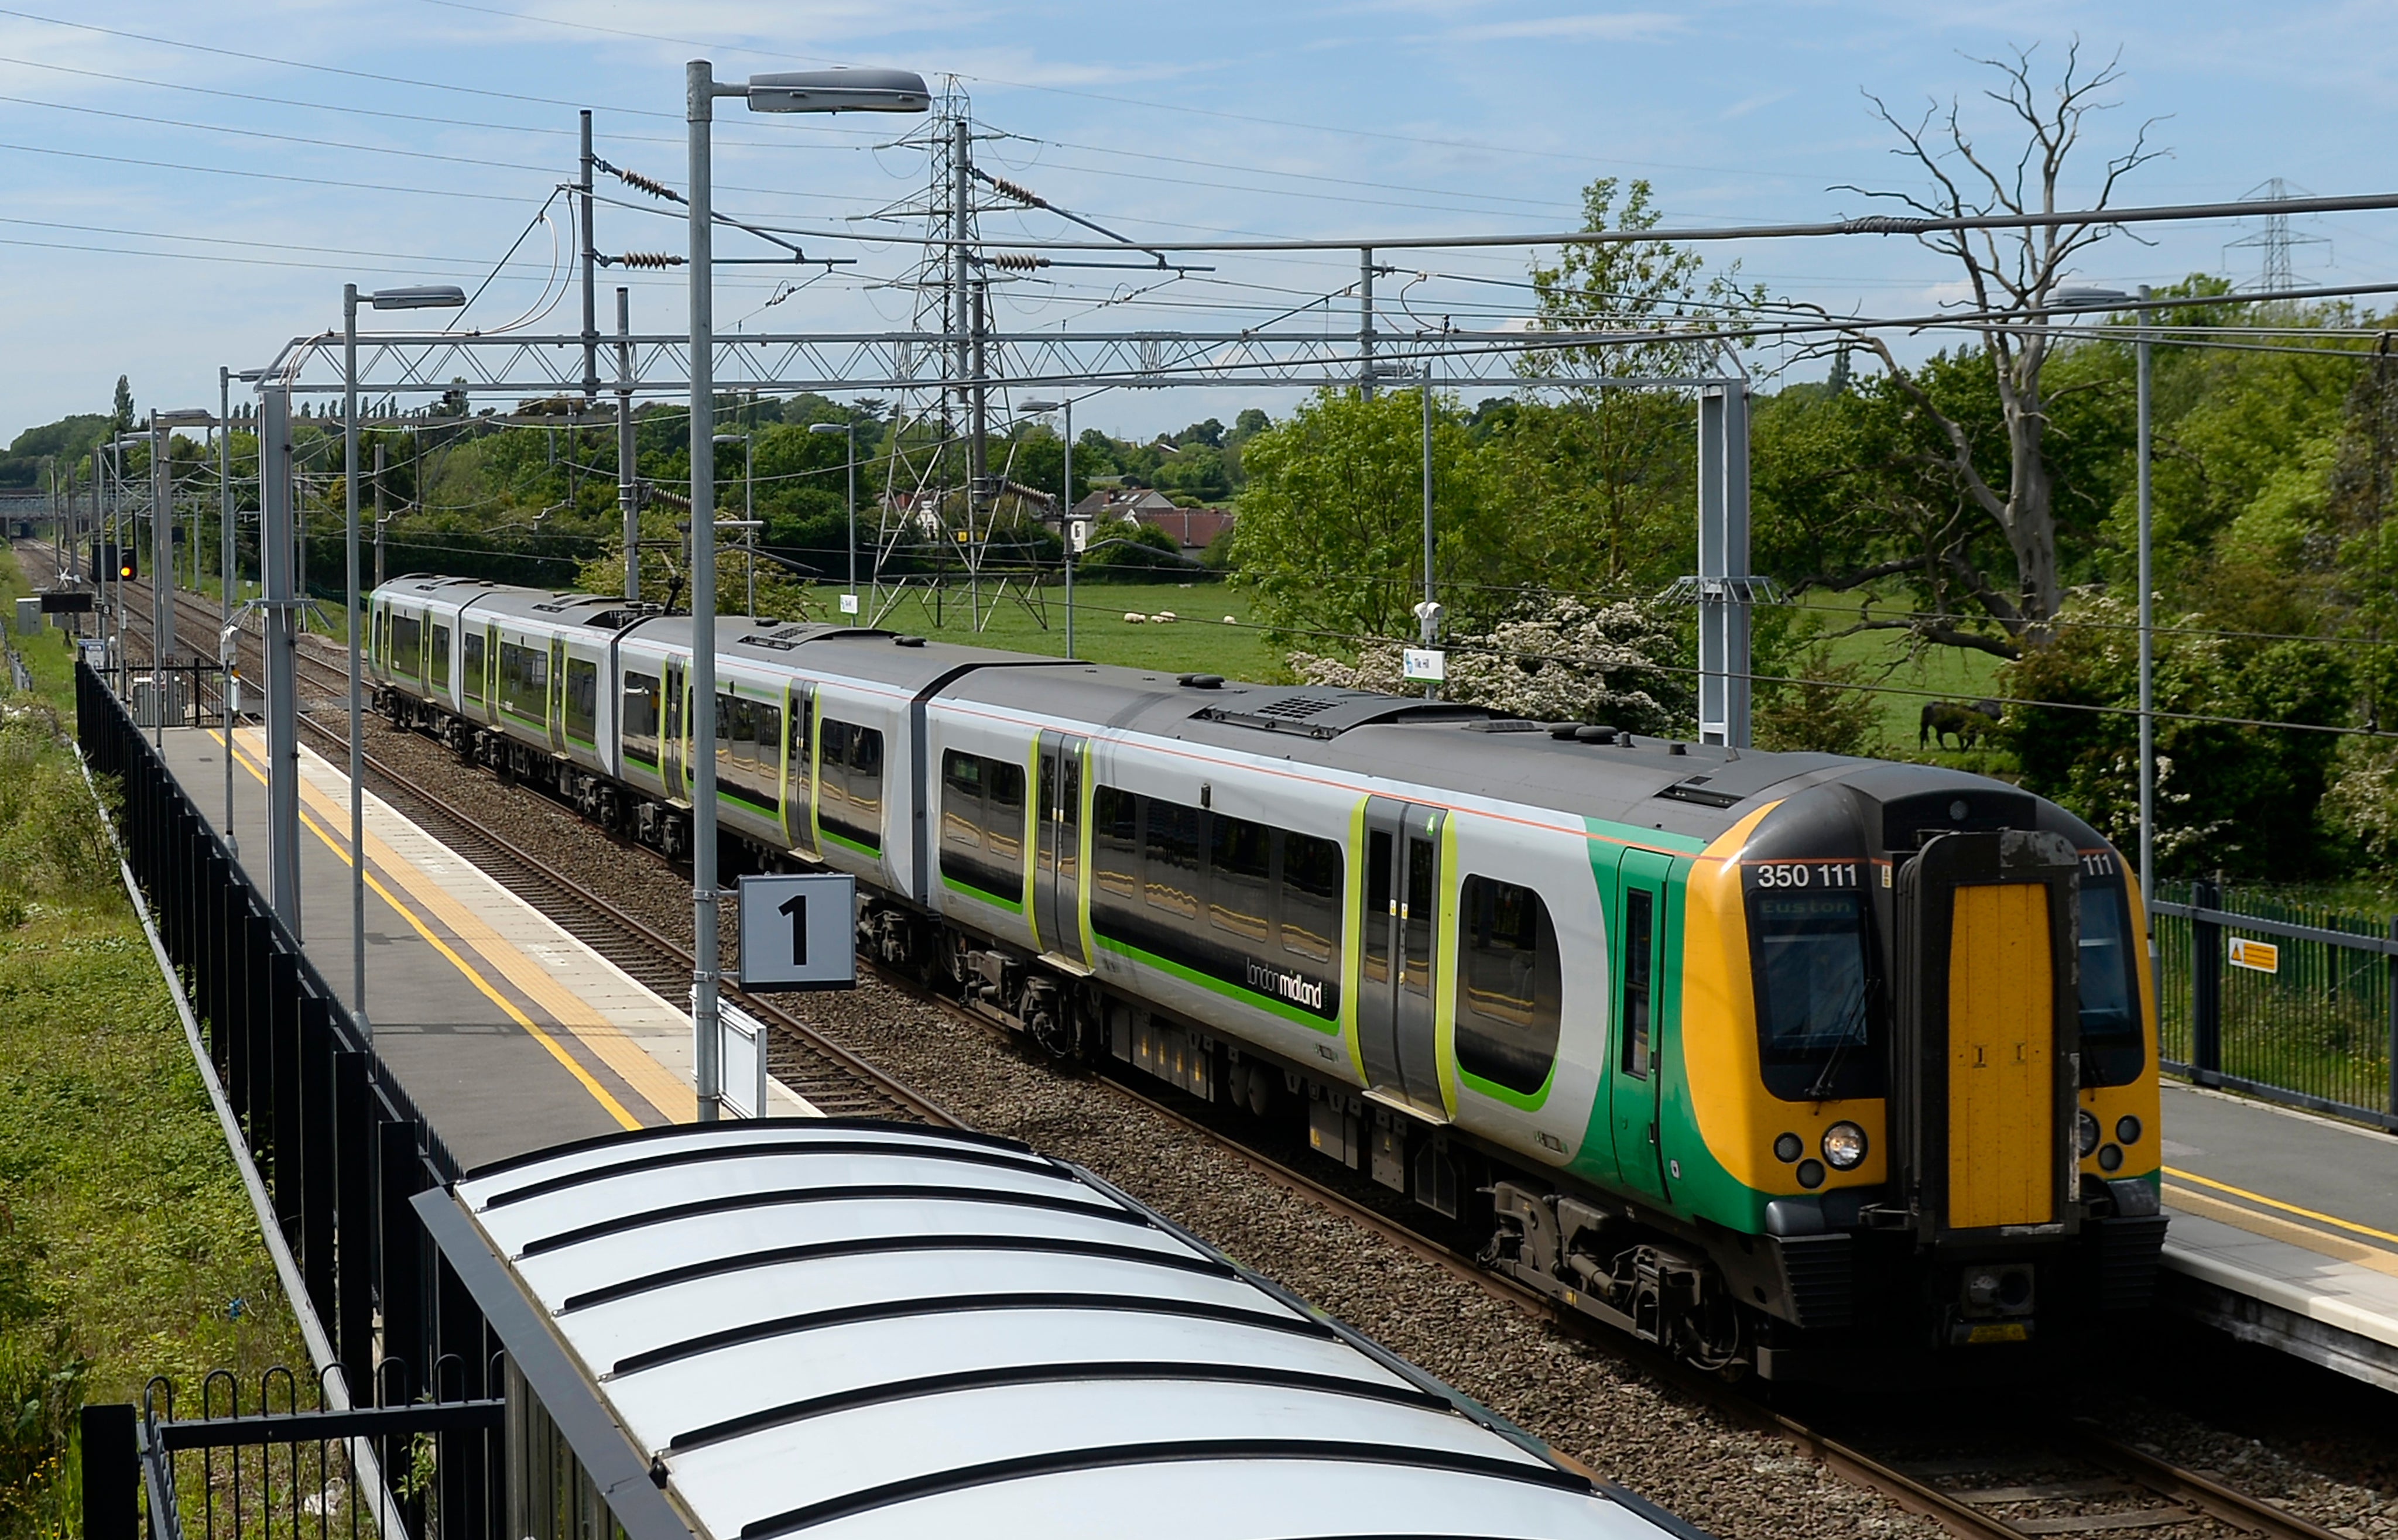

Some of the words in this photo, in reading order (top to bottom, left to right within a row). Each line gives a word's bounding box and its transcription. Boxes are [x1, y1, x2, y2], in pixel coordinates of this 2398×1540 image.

[103, 605, 109, 614] 8
[1758, 864, 1809, 887] 350
[1818, 864, 1857, 887] 111
[2082, 855, 2113, 876] 111
[1762, 900, 1850, 913] Euston
[777, 895, 807, 965] 1
